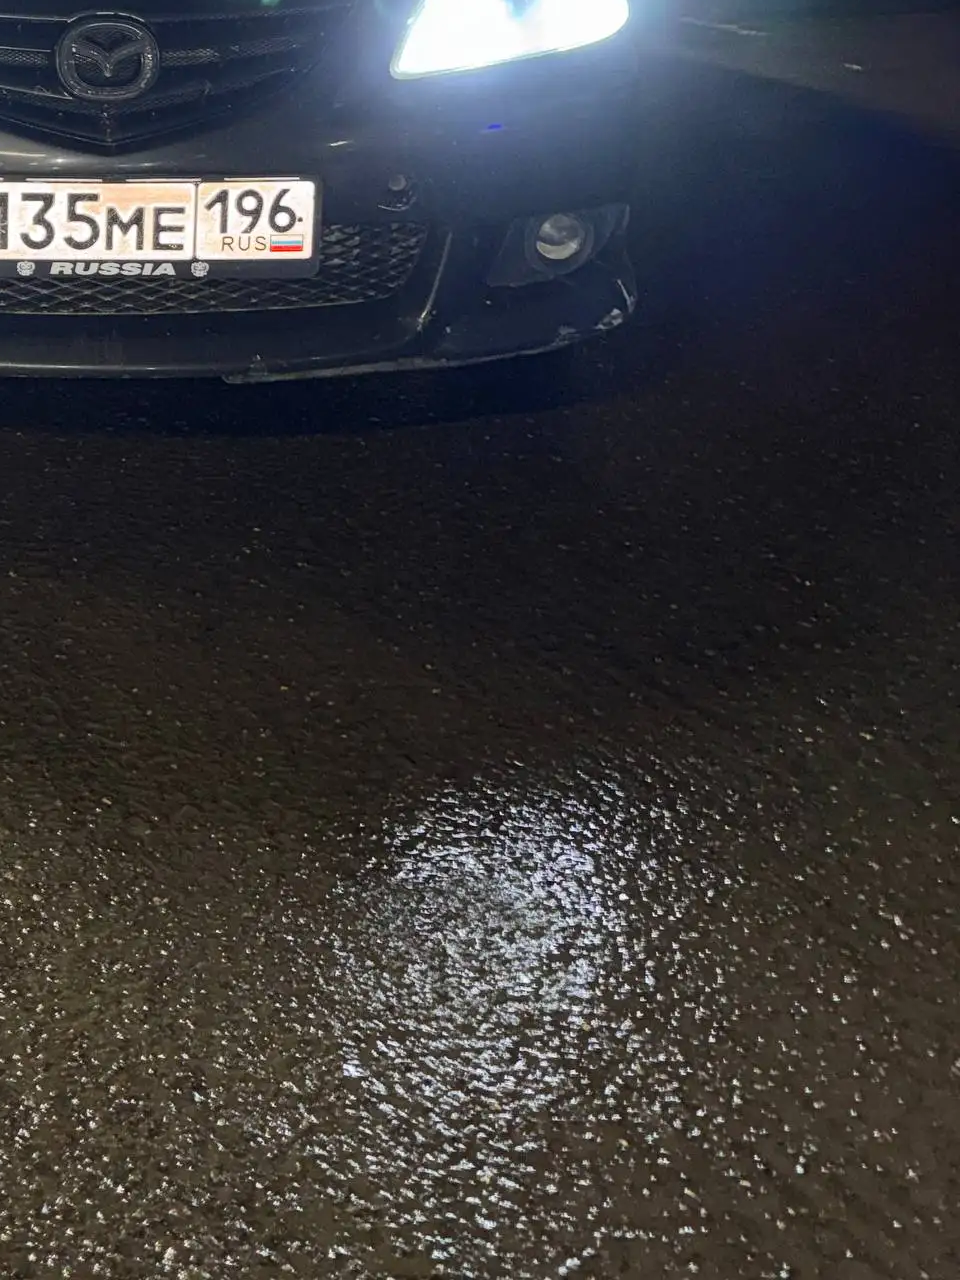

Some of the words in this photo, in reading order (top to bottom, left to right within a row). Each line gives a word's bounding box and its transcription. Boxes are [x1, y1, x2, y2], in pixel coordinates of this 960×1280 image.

[204, 188, 297, 234] 196
[221, 235, 267, 252] RUS
[49, 261, 177, 276] RUSSIA
